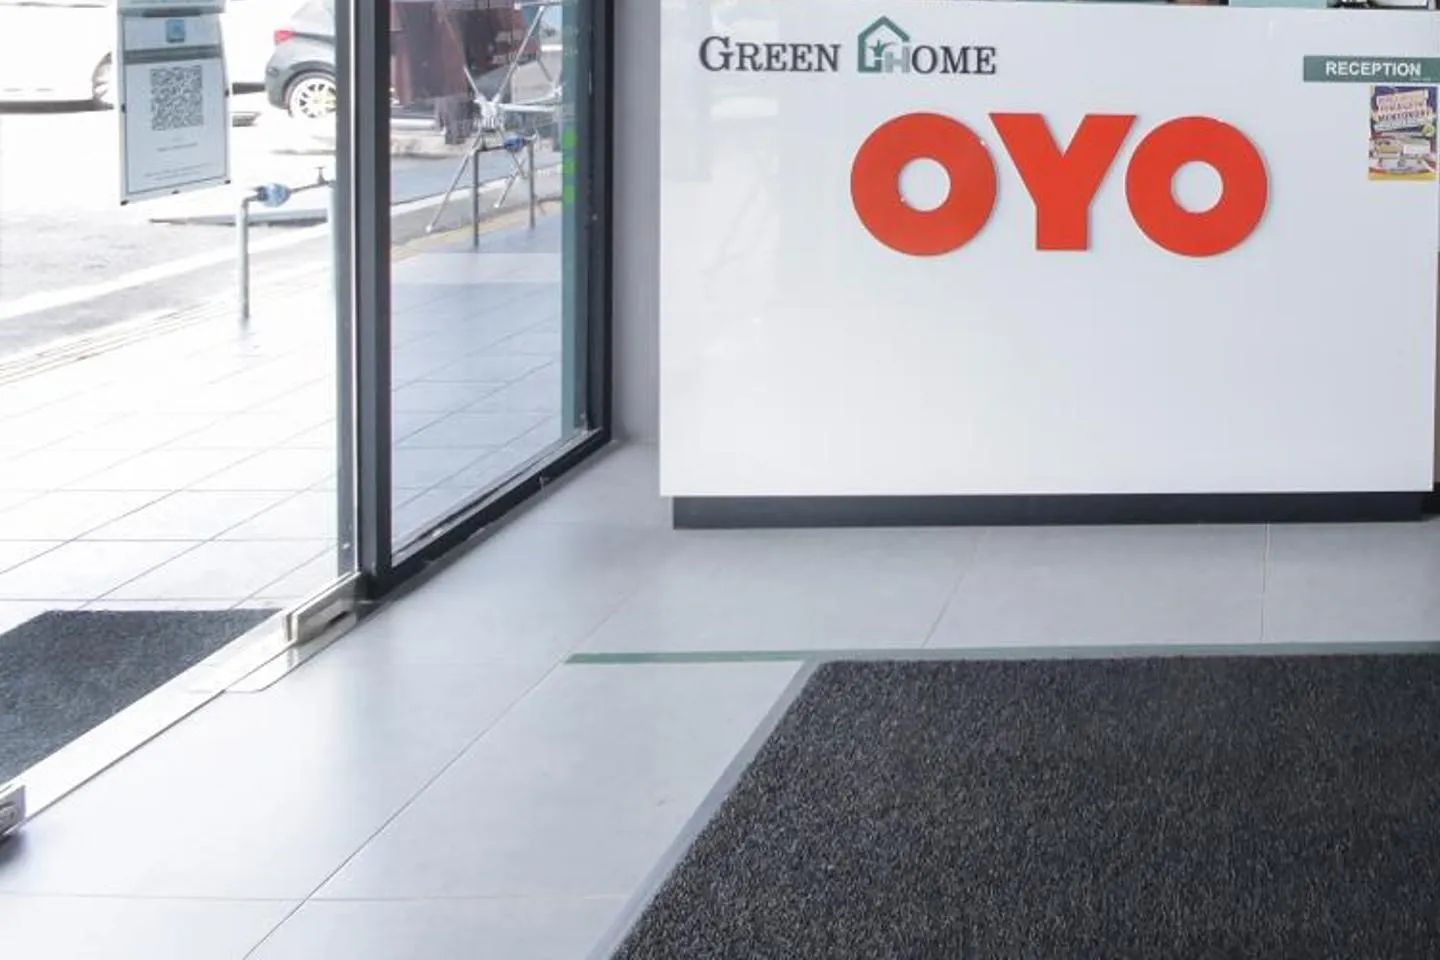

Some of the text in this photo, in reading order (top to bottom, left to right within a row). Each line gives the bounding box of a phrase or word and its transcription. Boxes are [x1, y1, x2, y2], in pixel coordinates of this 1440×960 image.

[699, 36, 842, 73] GREEN
[1325, 61, 1422, 76] RECEPTION
[849, 112, 1268, 258] OYO
